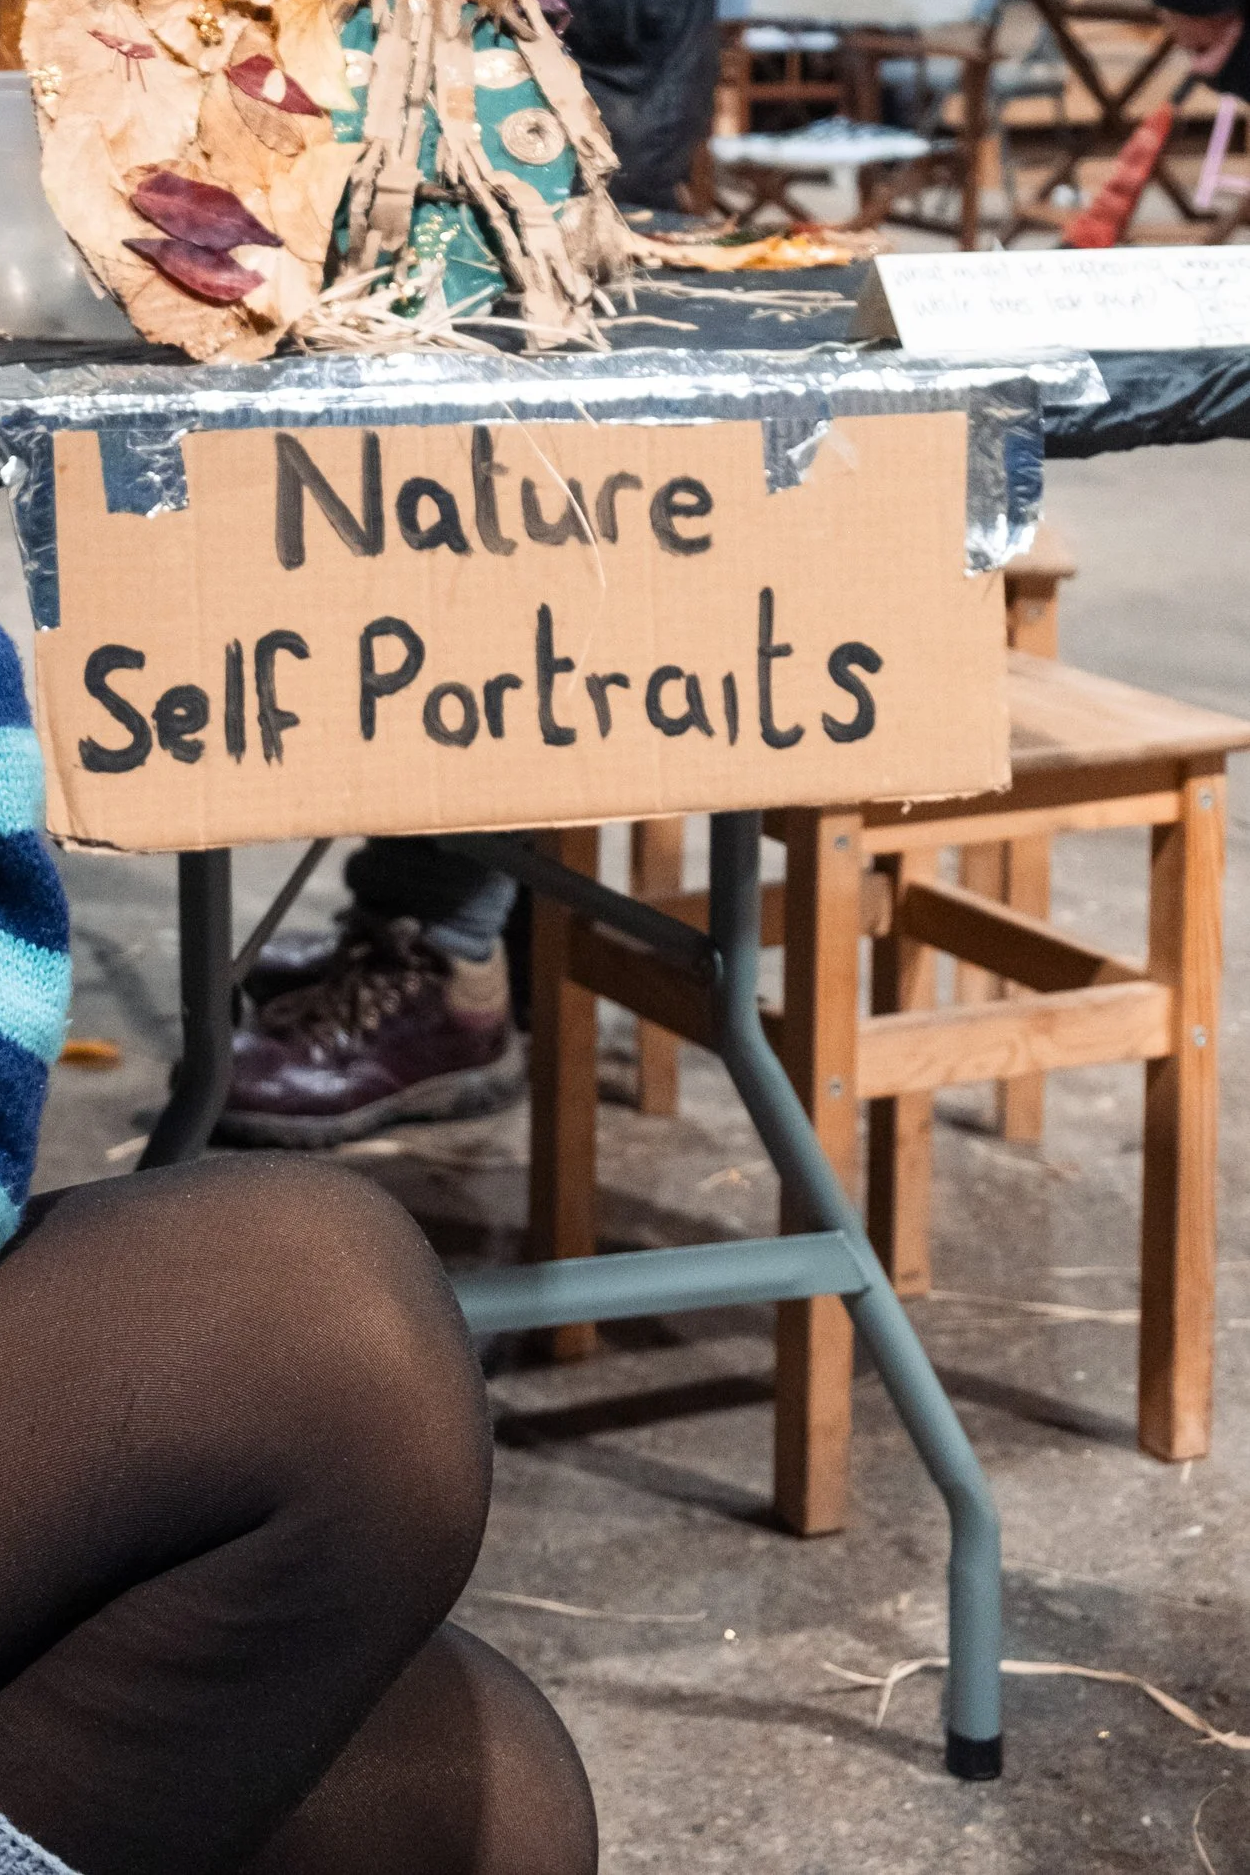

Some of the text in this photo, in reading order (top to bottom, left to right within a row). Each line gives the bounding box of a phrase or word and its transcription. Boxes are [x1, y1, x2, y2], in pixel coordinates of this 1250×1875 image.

[274, 426, 714, 570] Nature
[78, 587, 884, 774] Self Portraits
